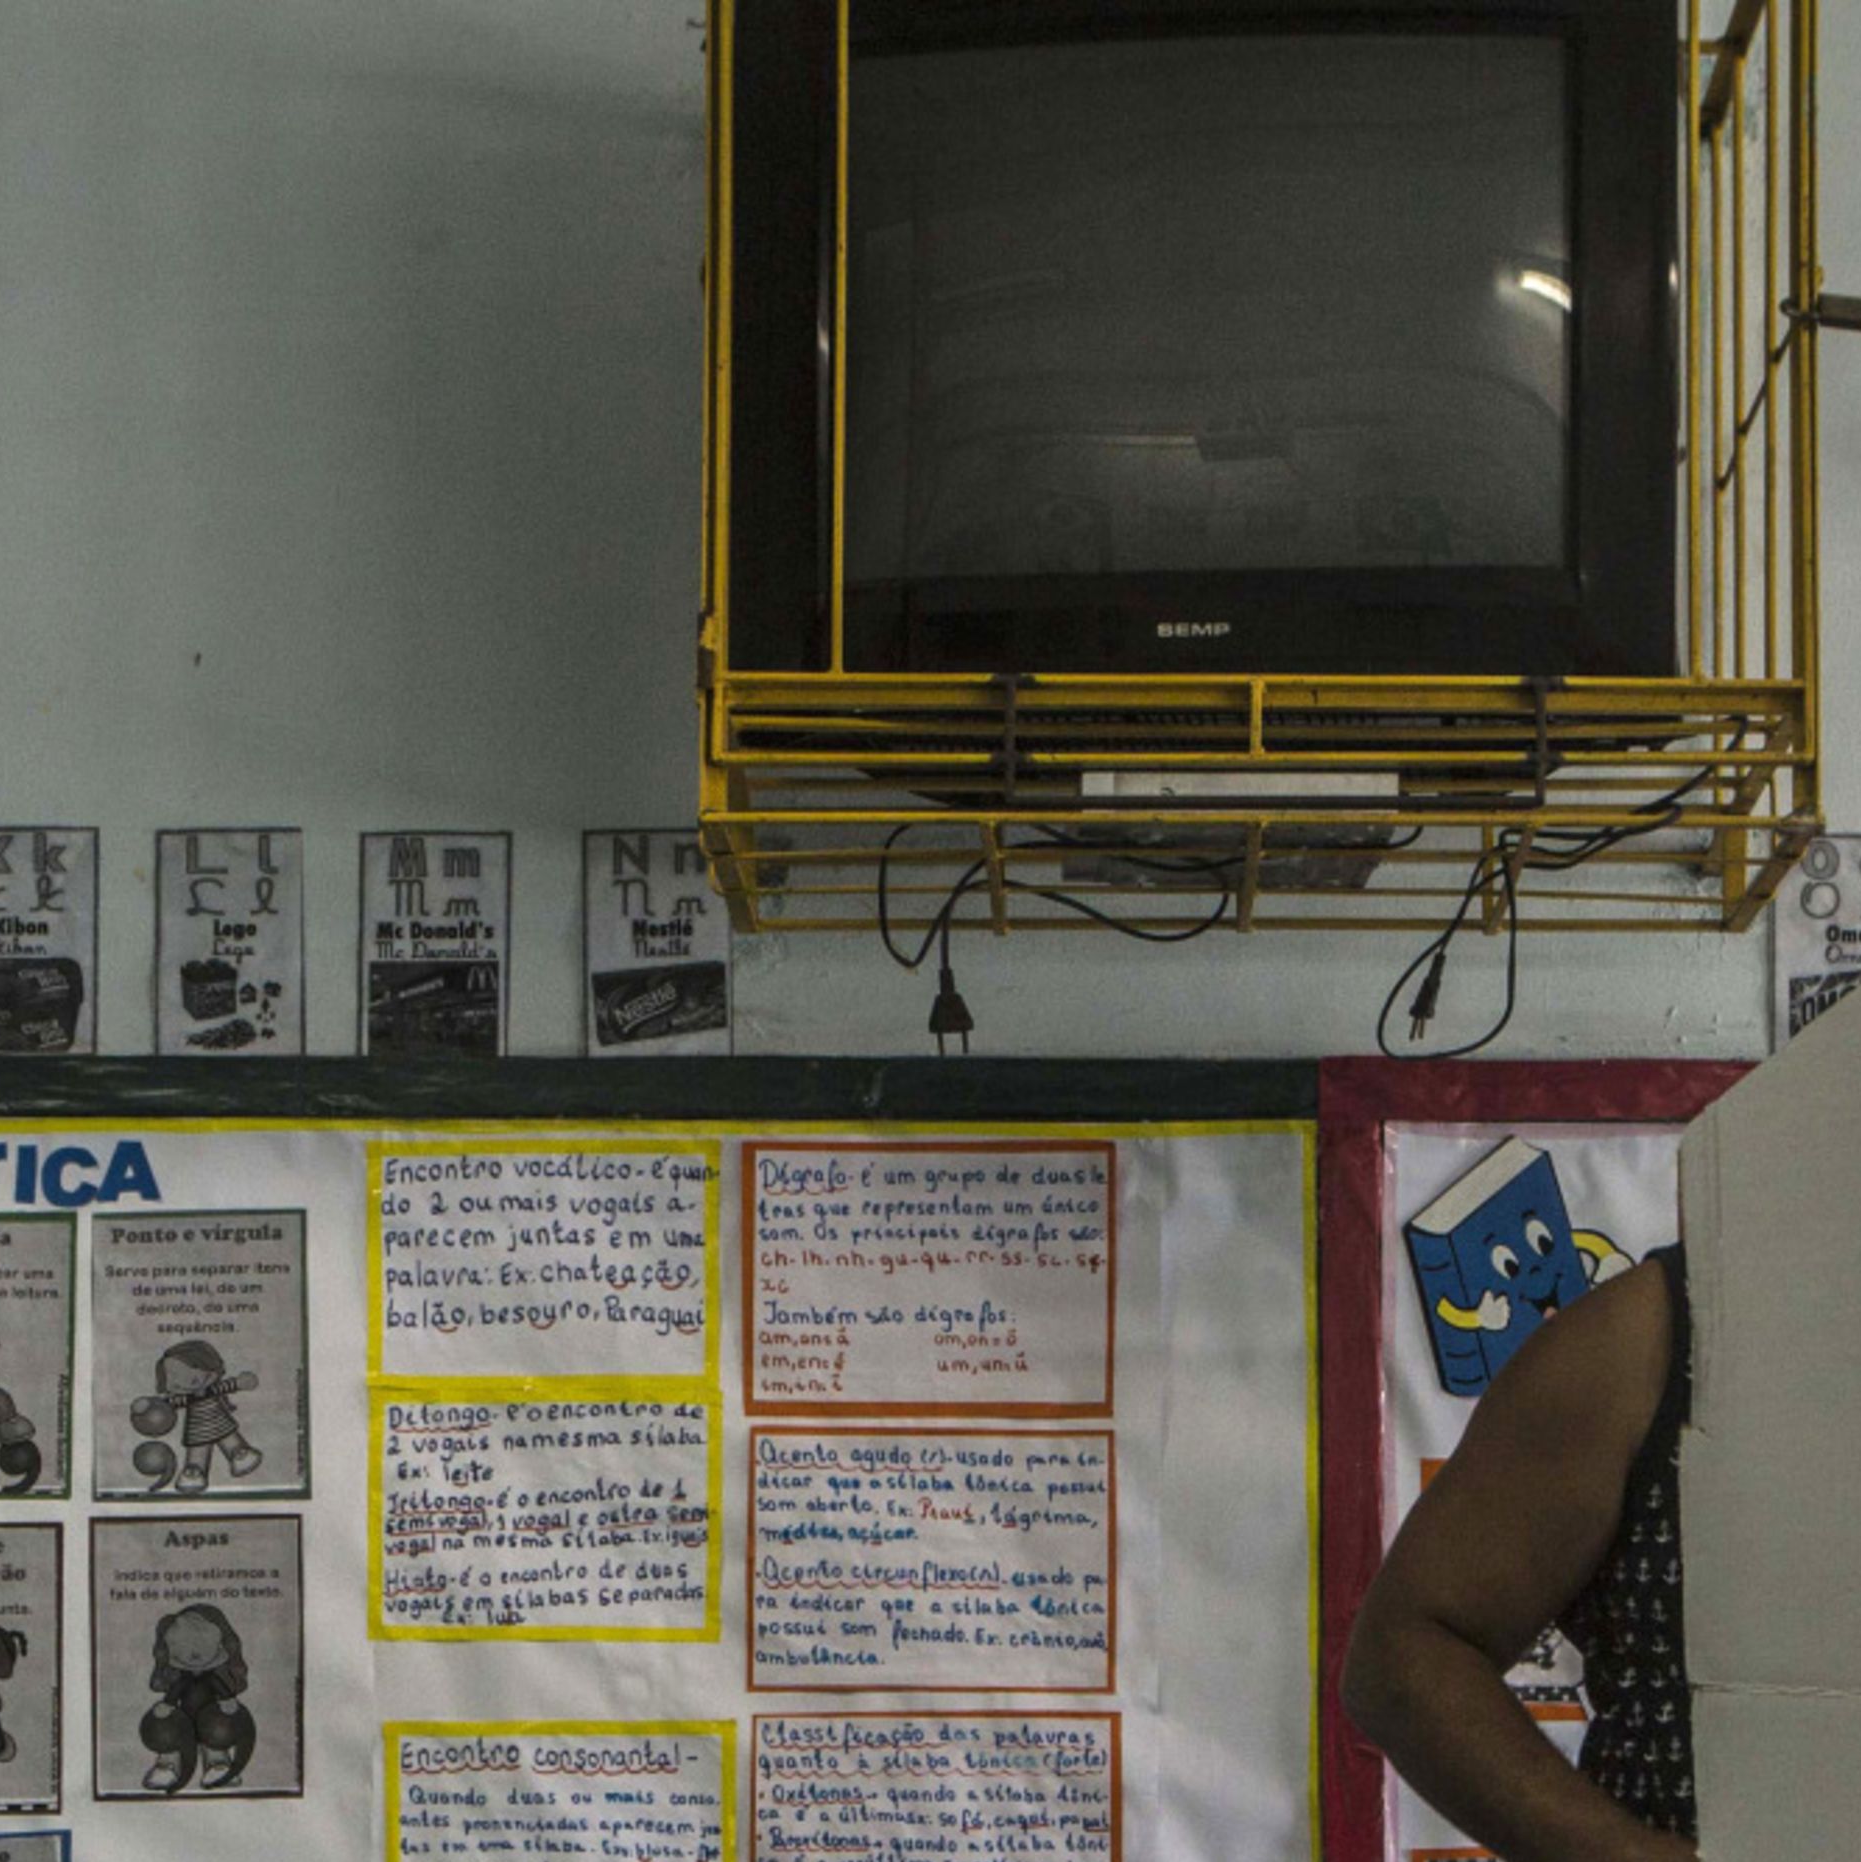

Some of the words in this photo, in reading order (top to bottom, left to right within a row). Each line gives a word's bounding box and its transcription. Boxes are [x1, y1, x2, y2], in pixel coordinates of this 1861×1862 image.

[1157, 622, 1231, 637] SEMP
[213, 920, 257, 939] Lego
[376, 921, 406, 939] Mc
[412, 920, 494, 939] Donald's
[632, 918, 693, 939] Nestlé
[384, 1153, 503, 1185] Encontro
[514, 1153, 630, 1182] vocálico
[651, 1150, 668, 1178] é
[382, 1195, 410, 1216] do
[430, 1192, 447, 1215] 2
[460, 1197, 492, 1212] ou
[500, 1193, 557, 1212] mais
[570, 1193, 655, 1225] vogais
[110, 1226, 177, 1246] Ponto
[185, 1231, 198, 1244] e
[207, 1222, 283, 1244] vírgula
[384, 1227, 495, 1255] parecem
[507, 1221, 595, 1252] juntas
[610, 1230, 650, 1248] em
[387, 1298, 472, 1330] balão,
[481, 1300, 600, 1327] besouro,
[603, 1295, 705, 1335] Paraguai
[164, 1529, 229, 1551] Aspas
[400, 1738, 520, 1769] Encontro
[534, 1739, 680, 1769] consonantal
